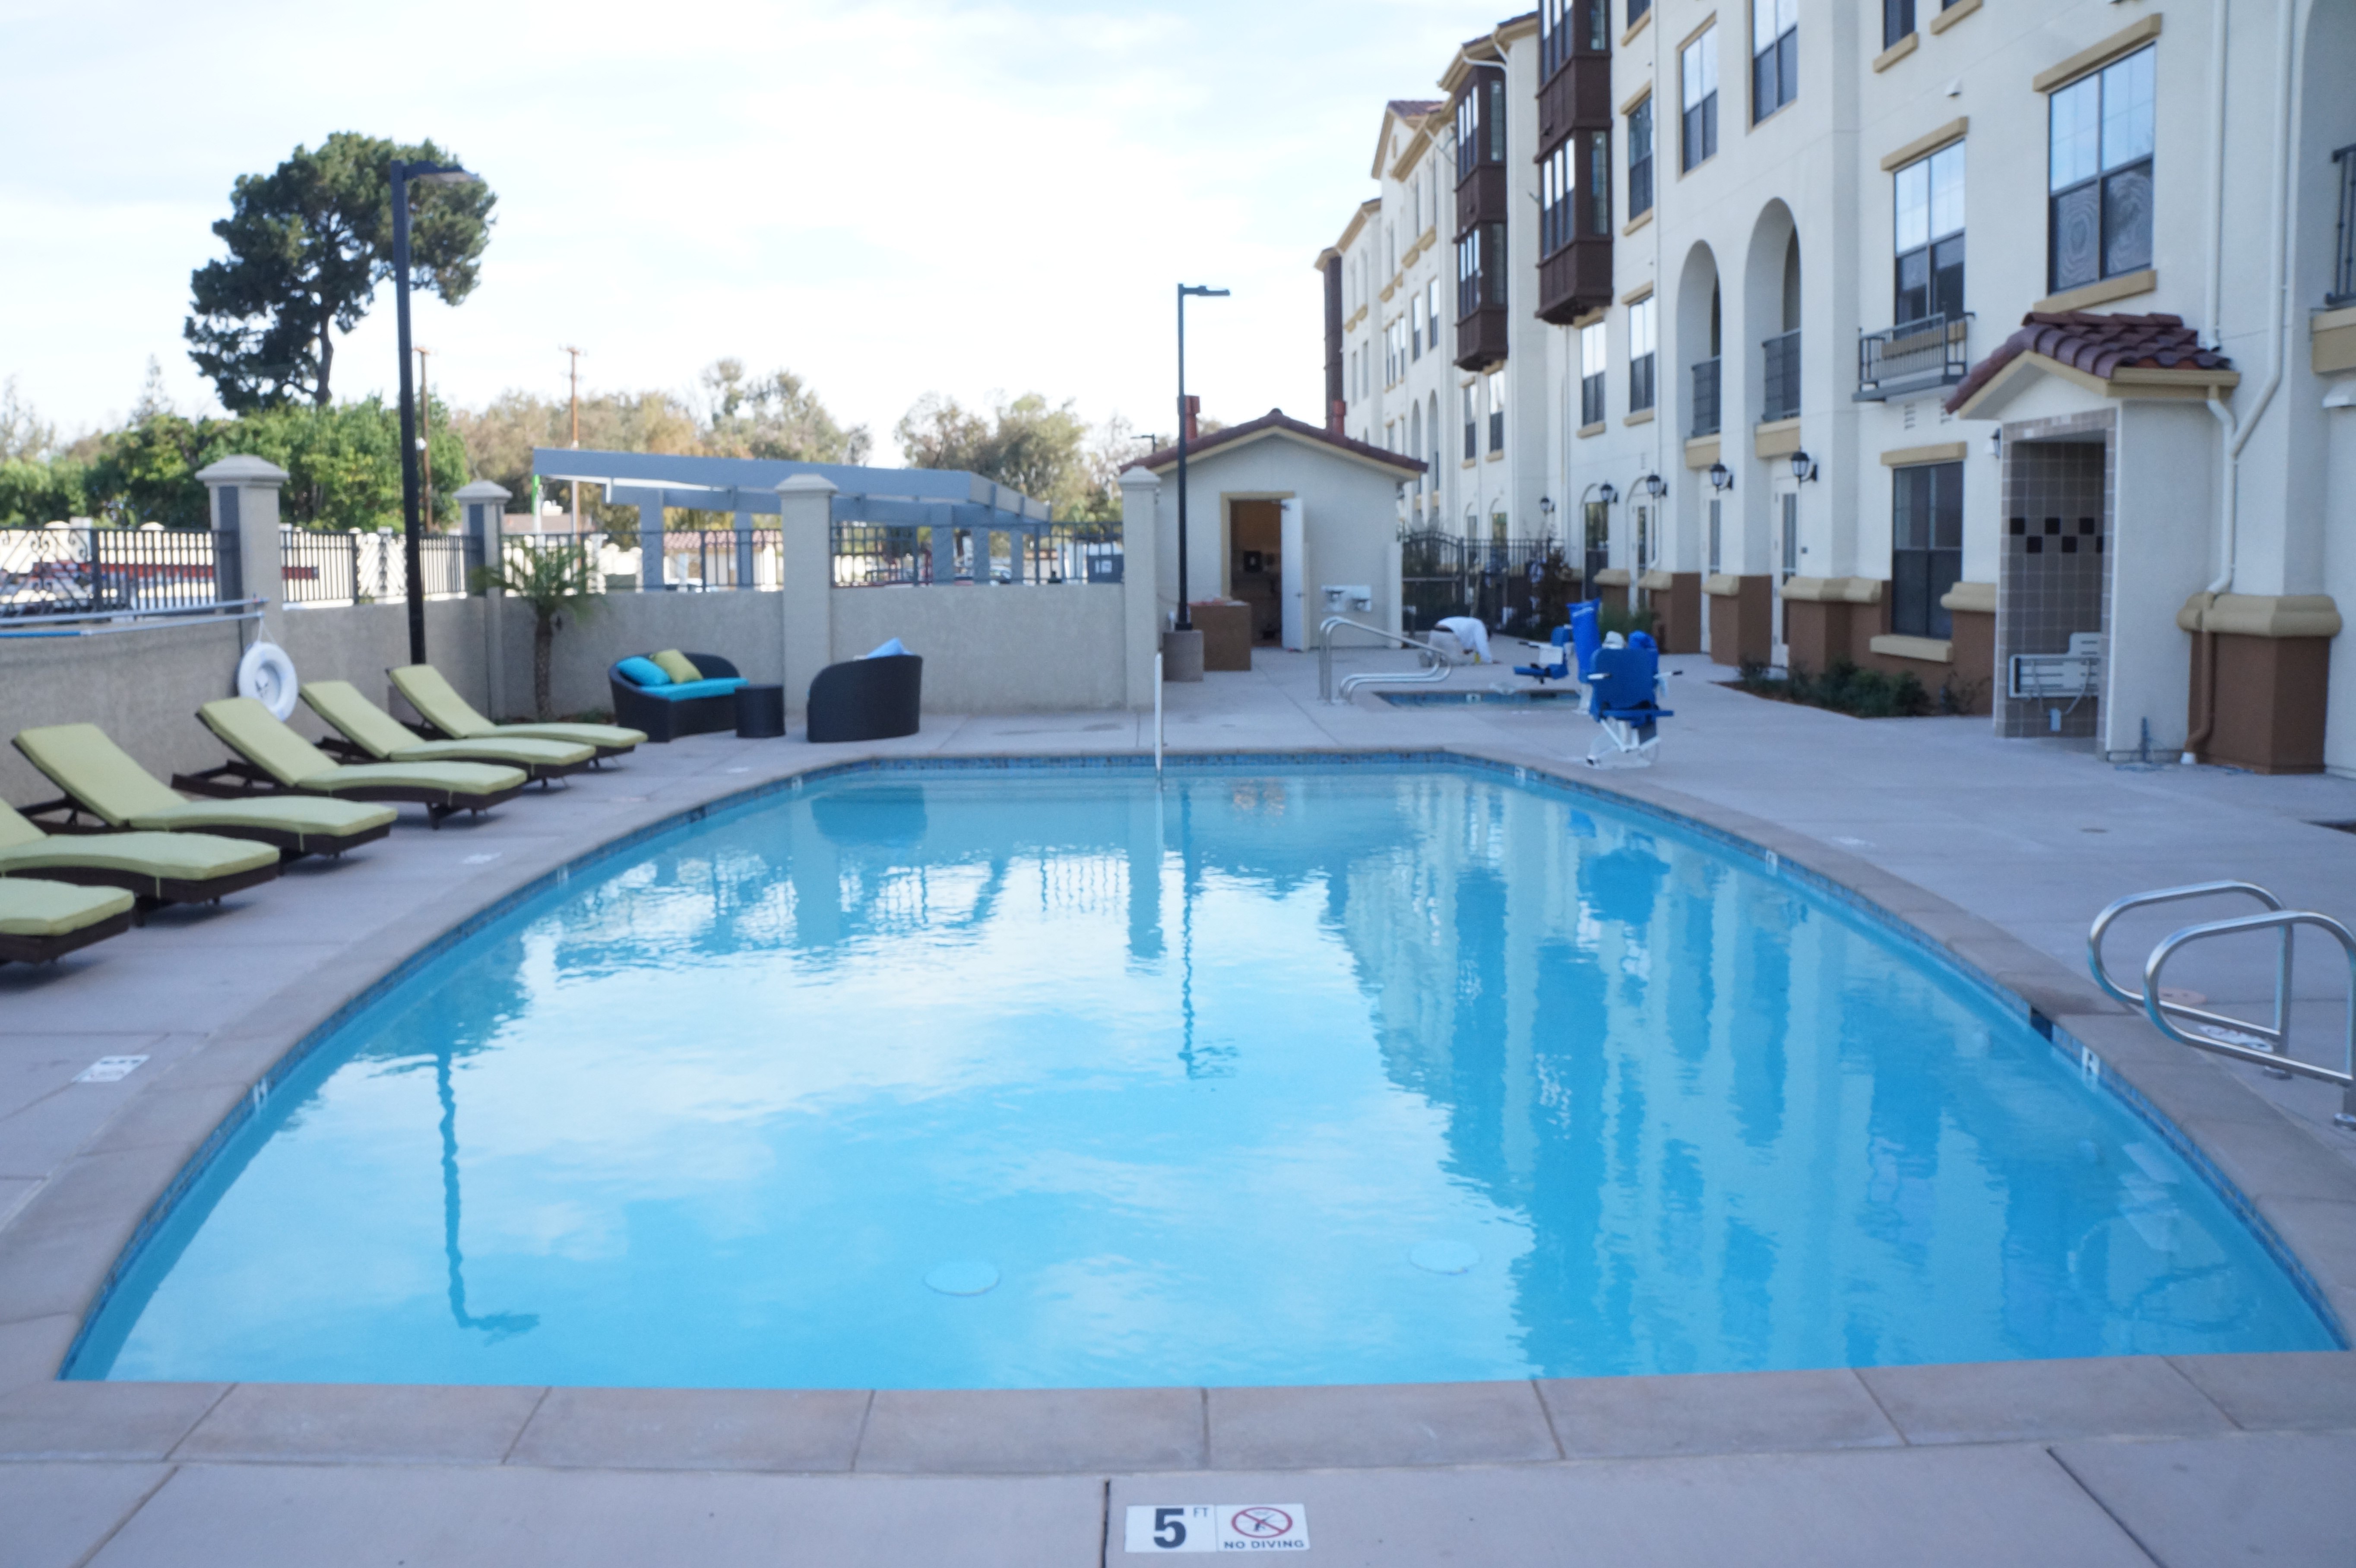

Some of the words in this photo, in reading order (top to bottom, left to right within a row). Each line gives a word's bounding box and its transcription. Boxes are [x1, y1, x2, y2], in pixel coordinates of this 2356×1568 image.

[1153, 1508, 1186, 1549] 5
[1194, 1508, 1208, 1517] FT
[1251, 1540, 1304, 1548] DIVING
